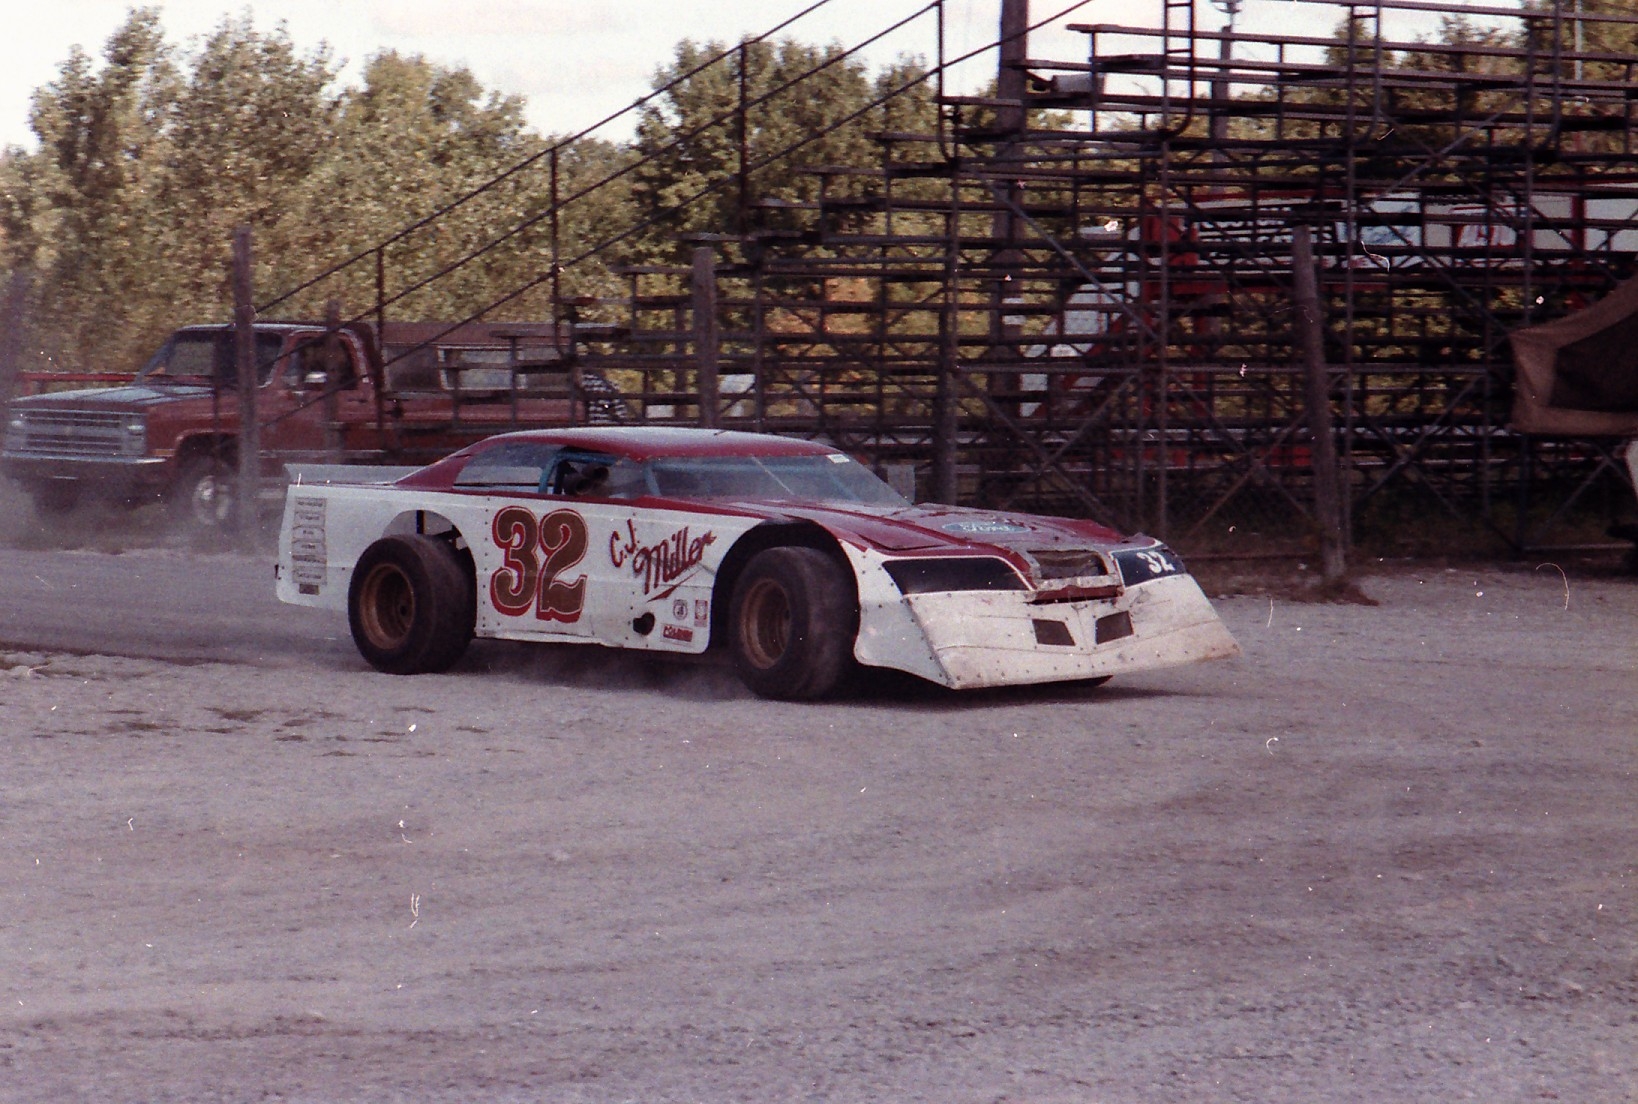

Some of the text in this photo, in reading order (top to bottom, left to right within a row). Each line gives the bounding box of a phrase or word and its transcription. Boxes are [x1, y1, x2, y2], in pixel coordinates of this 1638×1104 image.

[490, 505, 589, 623] 32
[632, 525, 717, 595] Miller
[1136, 551, 1175, 574] 32
